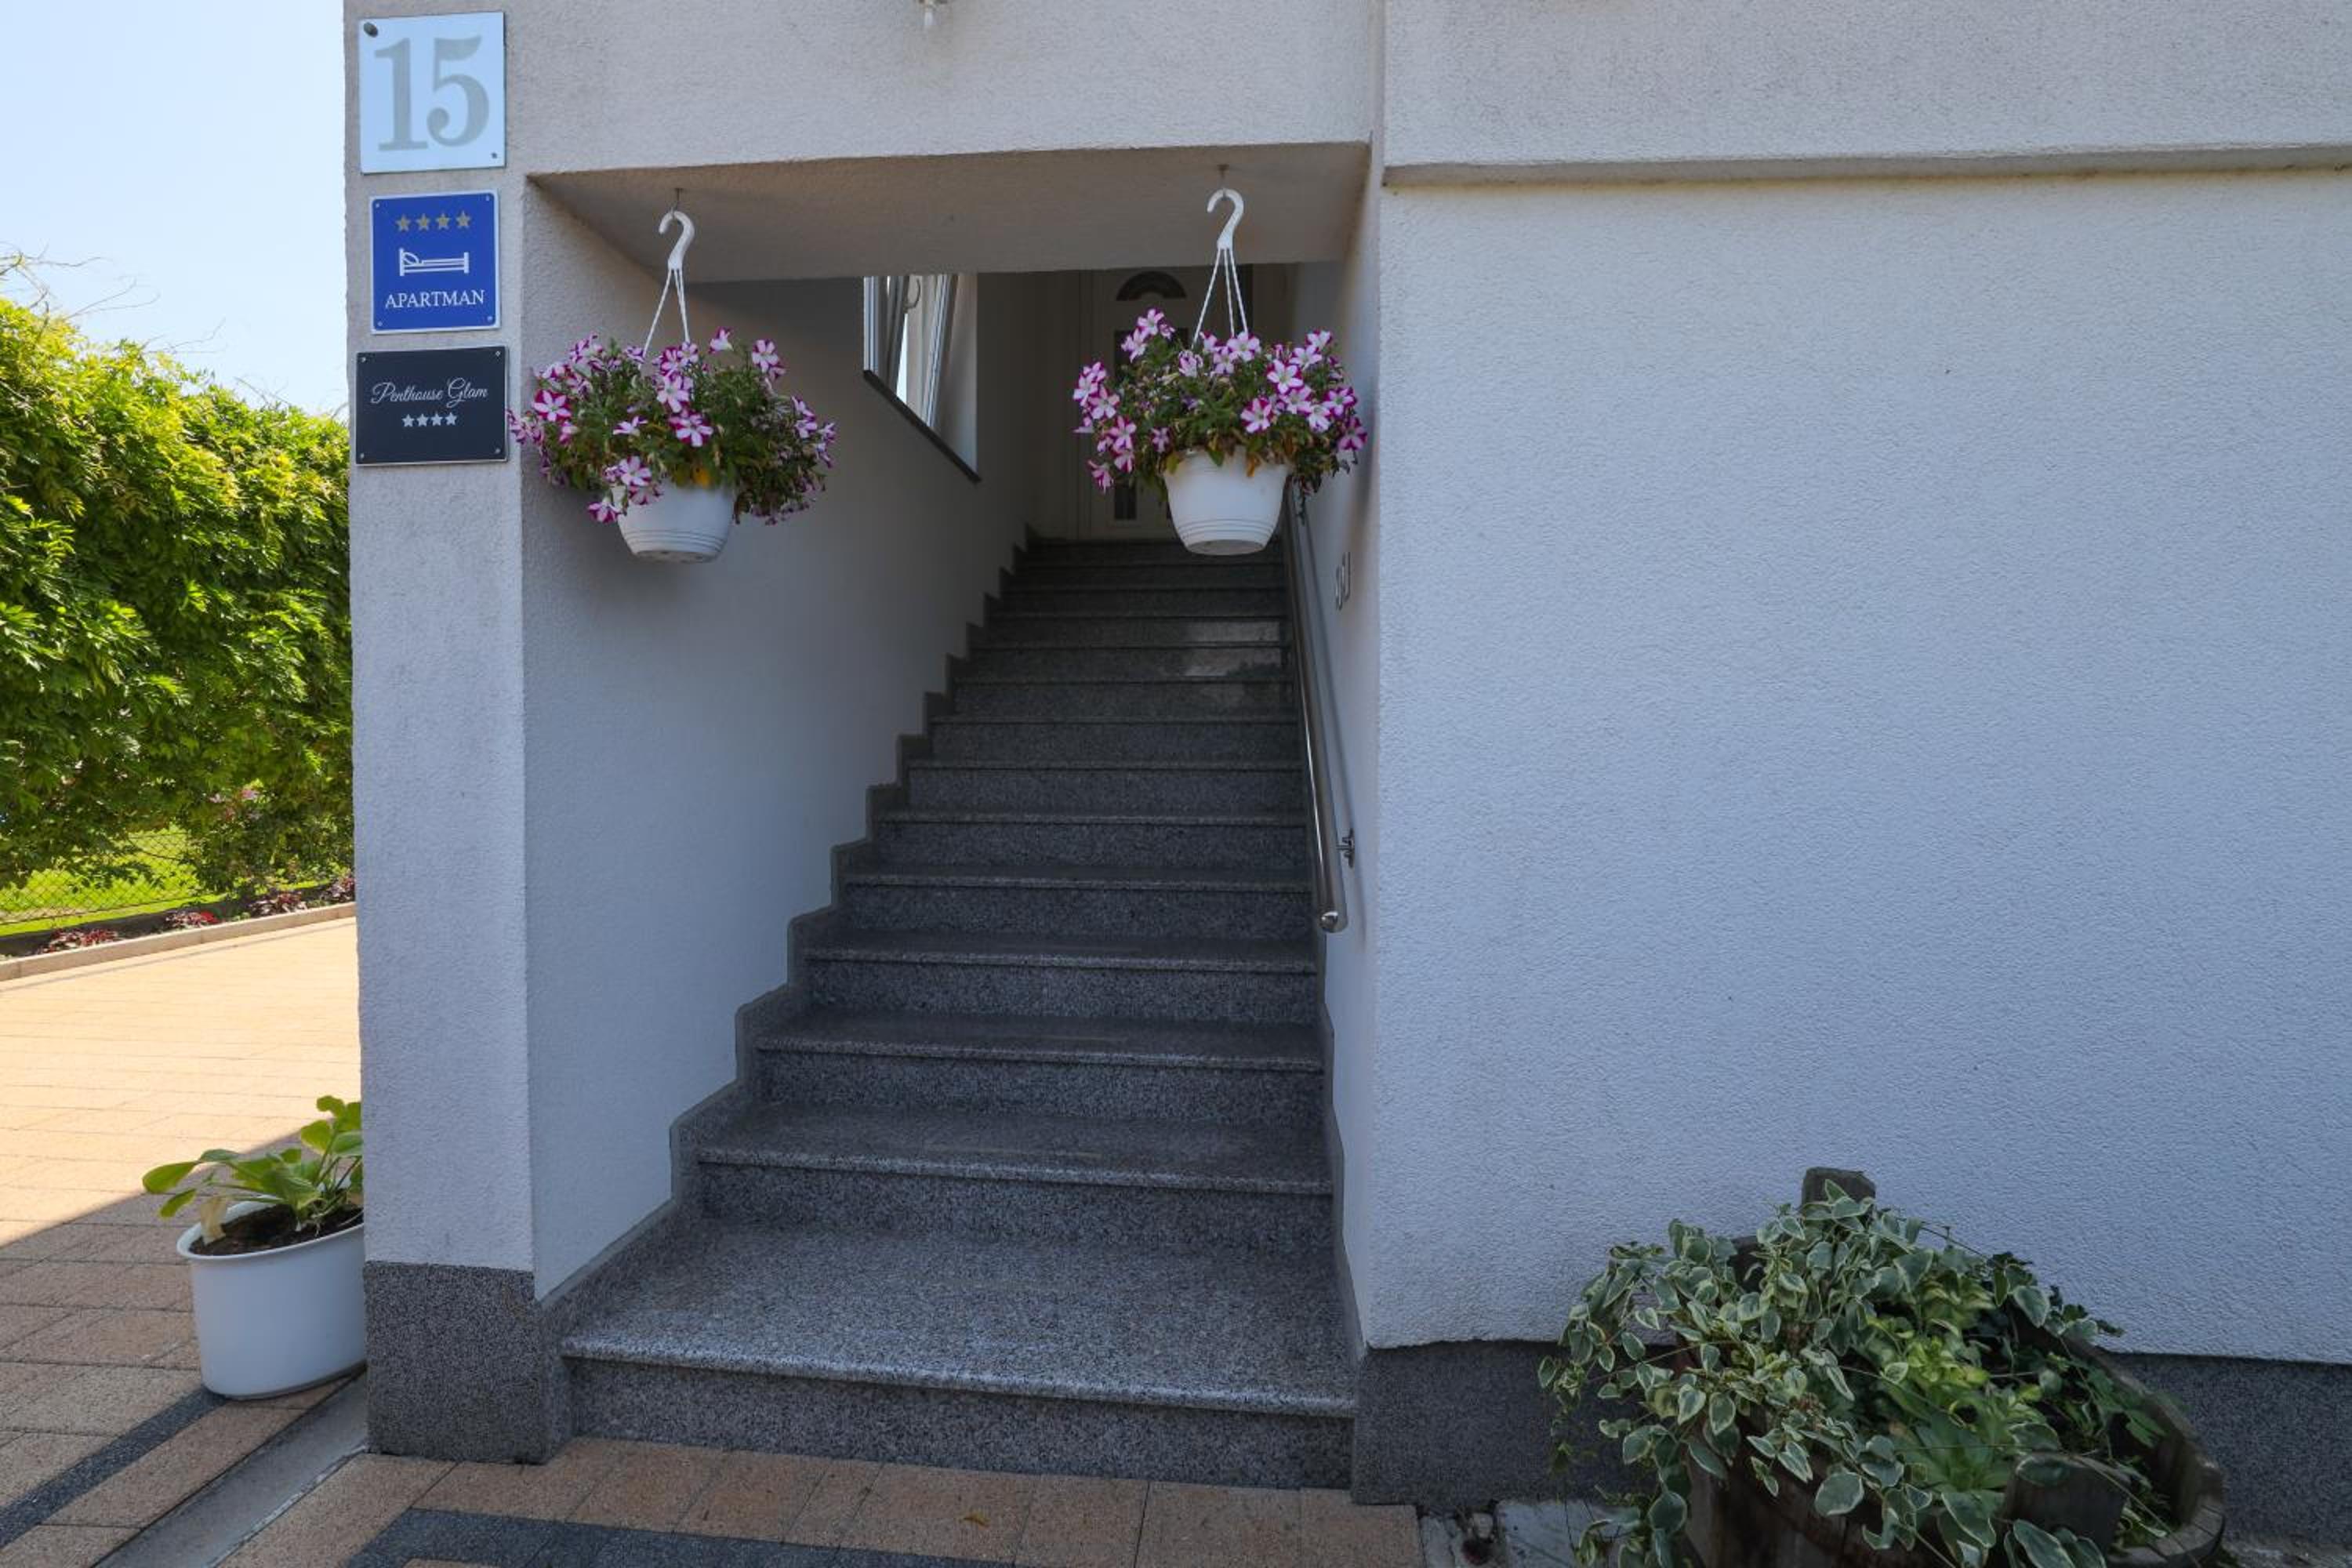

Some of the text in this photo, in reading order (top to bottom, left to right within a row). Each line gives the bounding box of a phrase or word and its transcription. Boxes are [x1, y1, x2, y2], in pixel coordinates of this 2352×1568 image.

[374, 35, 489, 151] 15
[385, 289, 485, 308] APARTMAN
[370, 377, 488, 408] Penthouse Glam
